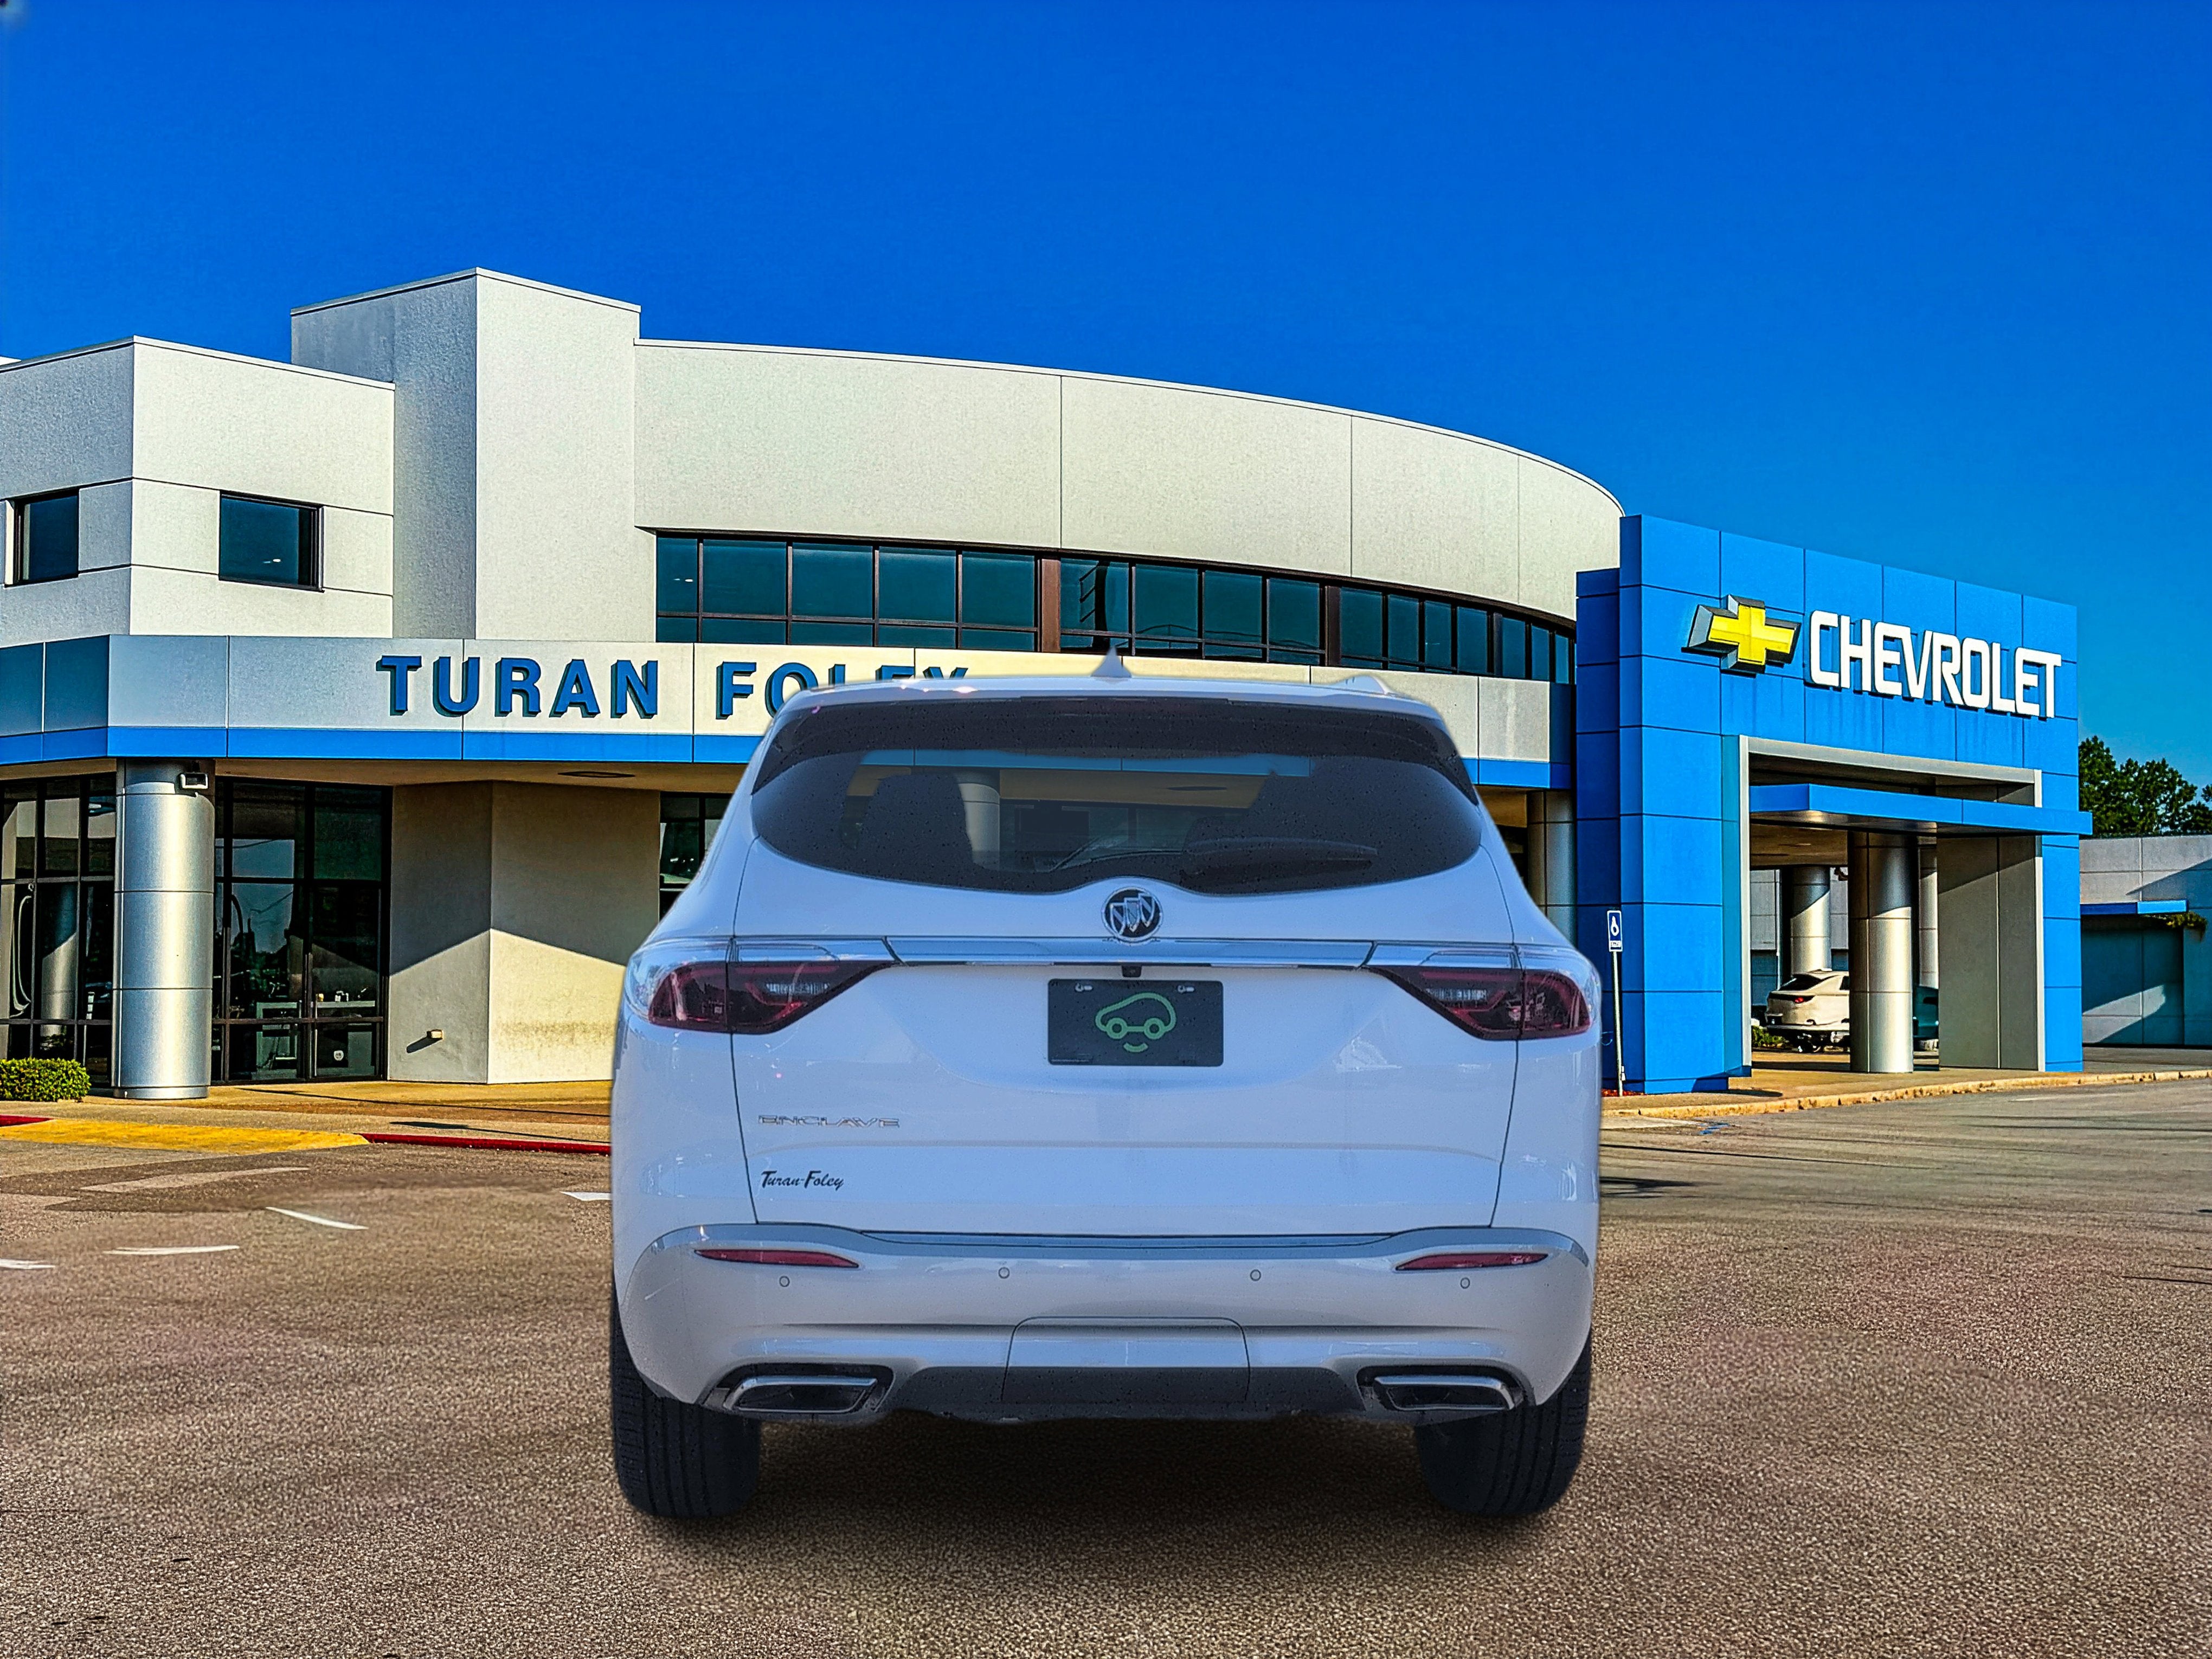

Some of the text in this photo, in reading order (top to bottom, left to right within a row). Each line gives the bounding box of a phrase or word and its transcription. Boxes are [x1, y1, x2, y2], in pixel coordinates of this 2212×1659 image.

[376, 655, 659, 718] TURAN
[1810, 610, 2062, 718] CHEVROLET
[758, 1115, 901, 1128] ENCLAVE
